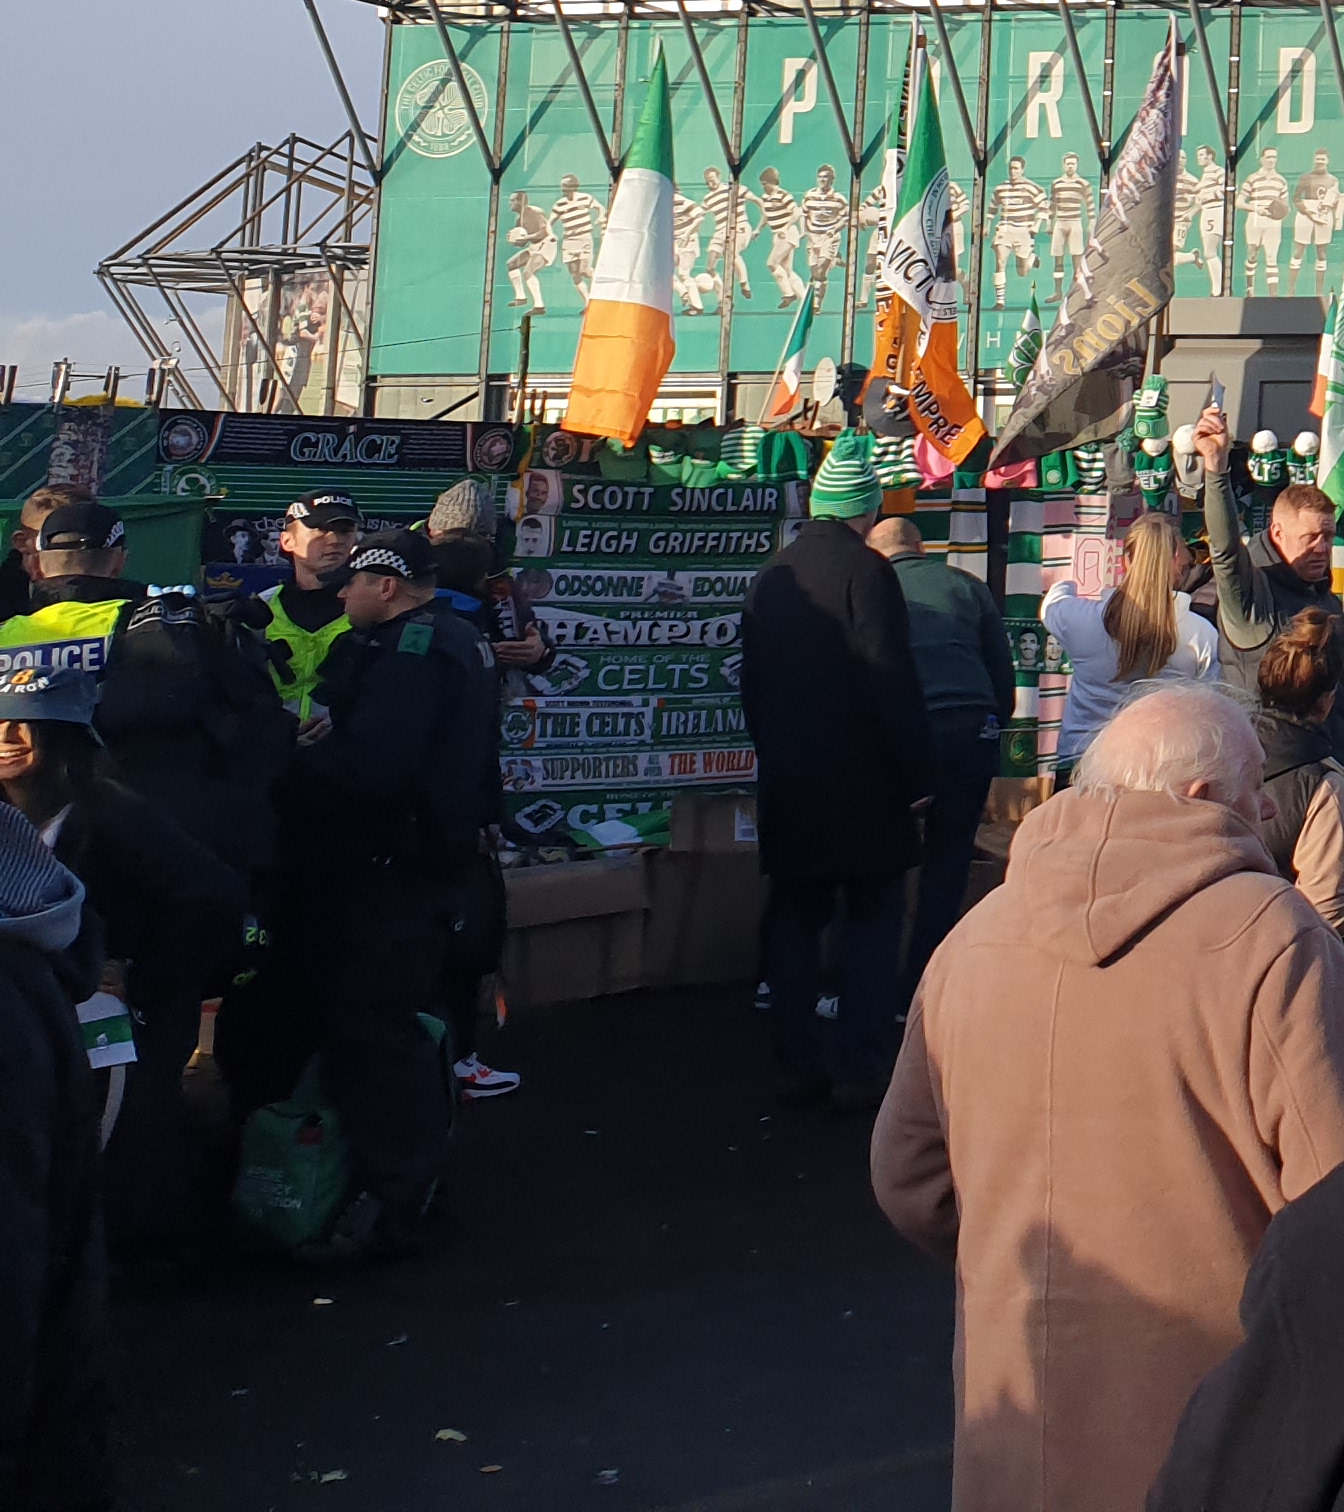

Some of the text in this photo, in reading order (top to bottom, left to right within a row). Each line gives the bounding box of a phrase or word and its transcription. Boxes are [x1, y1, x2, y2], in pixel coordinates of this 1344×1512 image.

[290, 432, 400, 464] GRACE
[570, 484, 778, 513] SCOTT SINCLAIR
[560, 529, 772, 555] LEIGH GRIFFITHS
[554, 574, 748, 598] ODSONNE EDOUA
[619, 609, 699, 619] PREMIER
[546, 618, 738, 647] HAMPIO
[600, 653, 711, 664] HOME OF THE
[597, 663, 710, 690] CELTS
[537, 710, 645, 738] THE CELTS
[541, 754, 639, 780] SUPPORTERS
[668, 753, 696, 775] THE
[702, 750, 756, 774] WORLD
